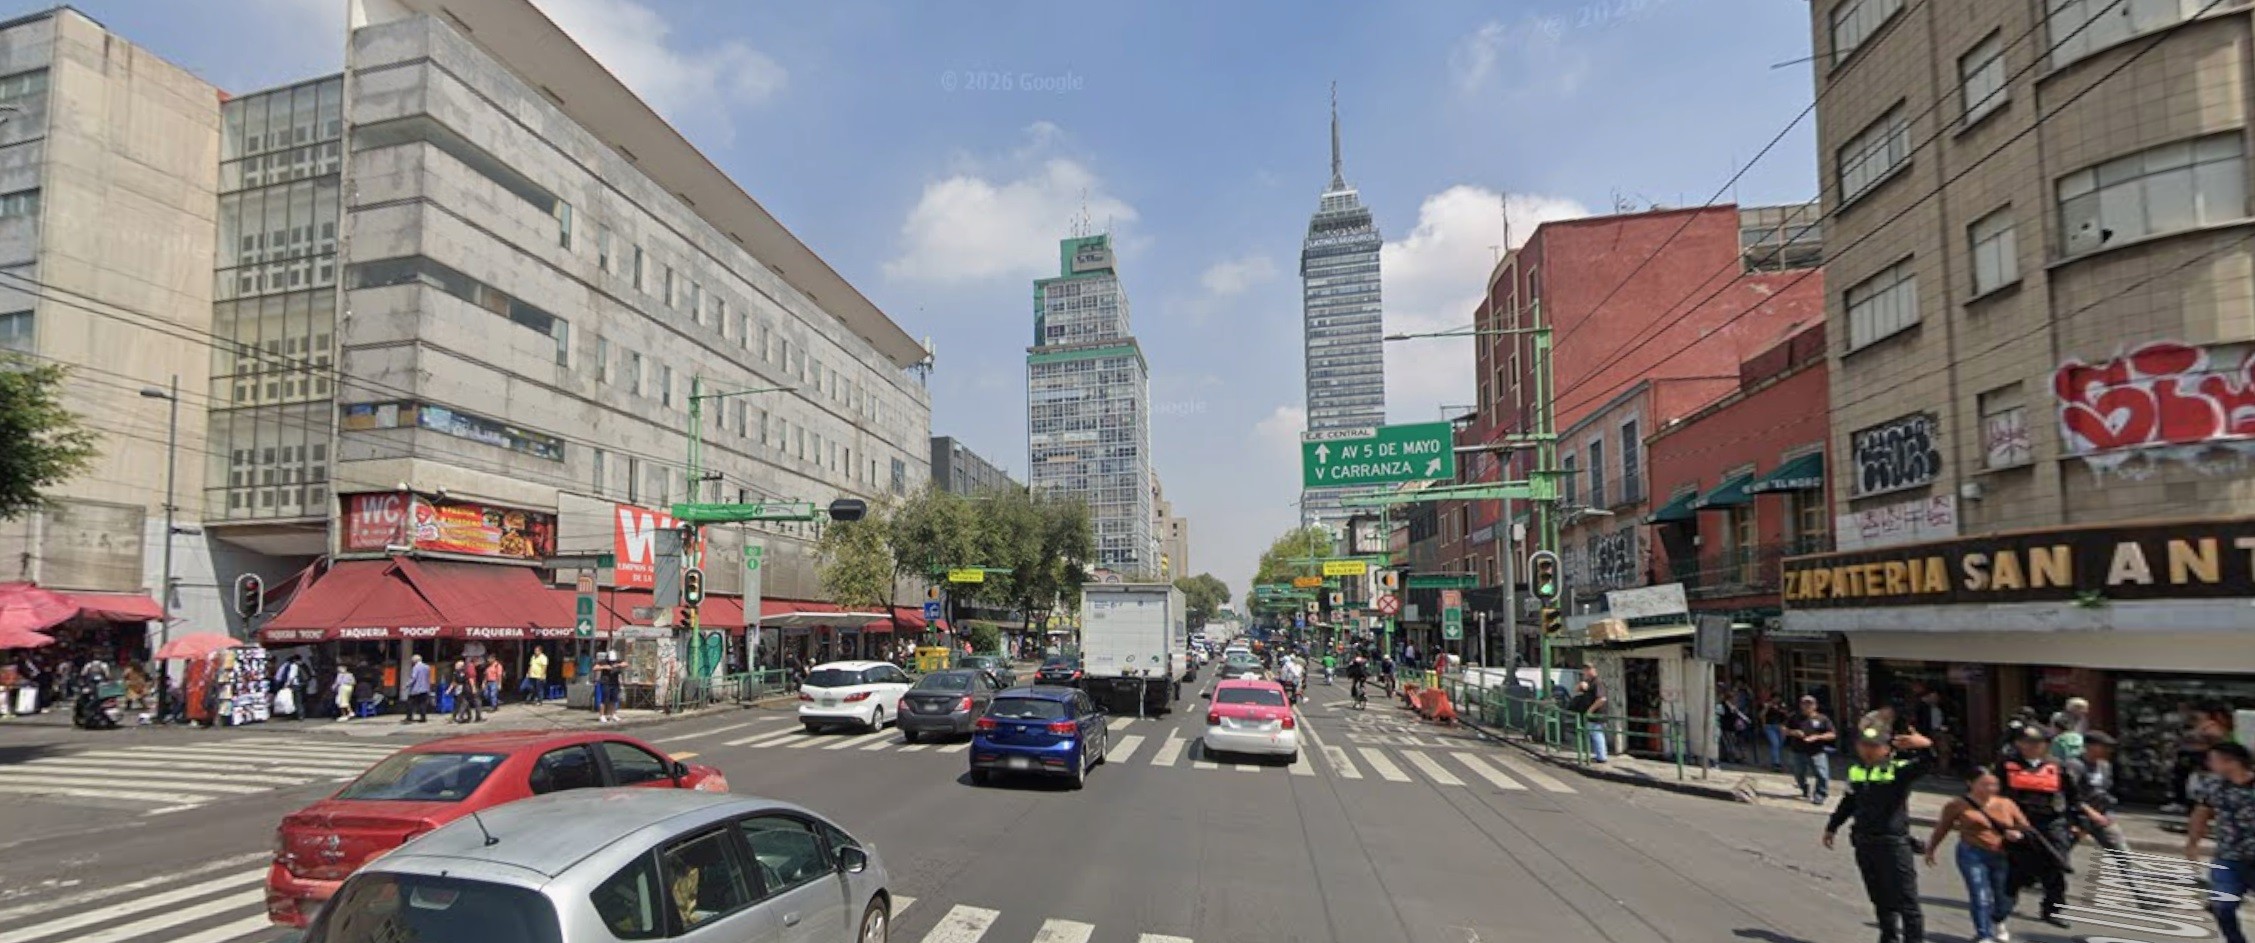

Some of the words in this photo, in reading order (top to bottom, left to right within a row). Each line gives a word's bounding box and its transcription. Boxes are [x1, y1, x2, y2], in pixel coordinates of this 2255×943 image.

[1309, 237, 1338, 247] LATINO
[1338, 233, 1377, 245] SEGUROS
[1305, 432, 1324, 441] EJE
[1327, 428, 1370, 439] CENTRAL
[1341, 445, 1358, 459] AV
[1364, 443, 1373, 458] 5
[1379, 442, 1397, 456] DE
[1402, 438, 1441, 454] MAYO
[1315, 467, 1325, 480] V
[1331, 461, 1413, 479] CARRANZA
[361, 495, 400, 524] WC
[1785, 556, 1950, 601] ZAPATERIA
[1963, 544, 2072, 592] SAN
[339, 627, 389, 640] TAQUERIA
[398, 625, 441, 637] "POCHO"
[465, 626, 524, 638] TAQUERIA
[530, 627, 575, 637] "POCHO"
